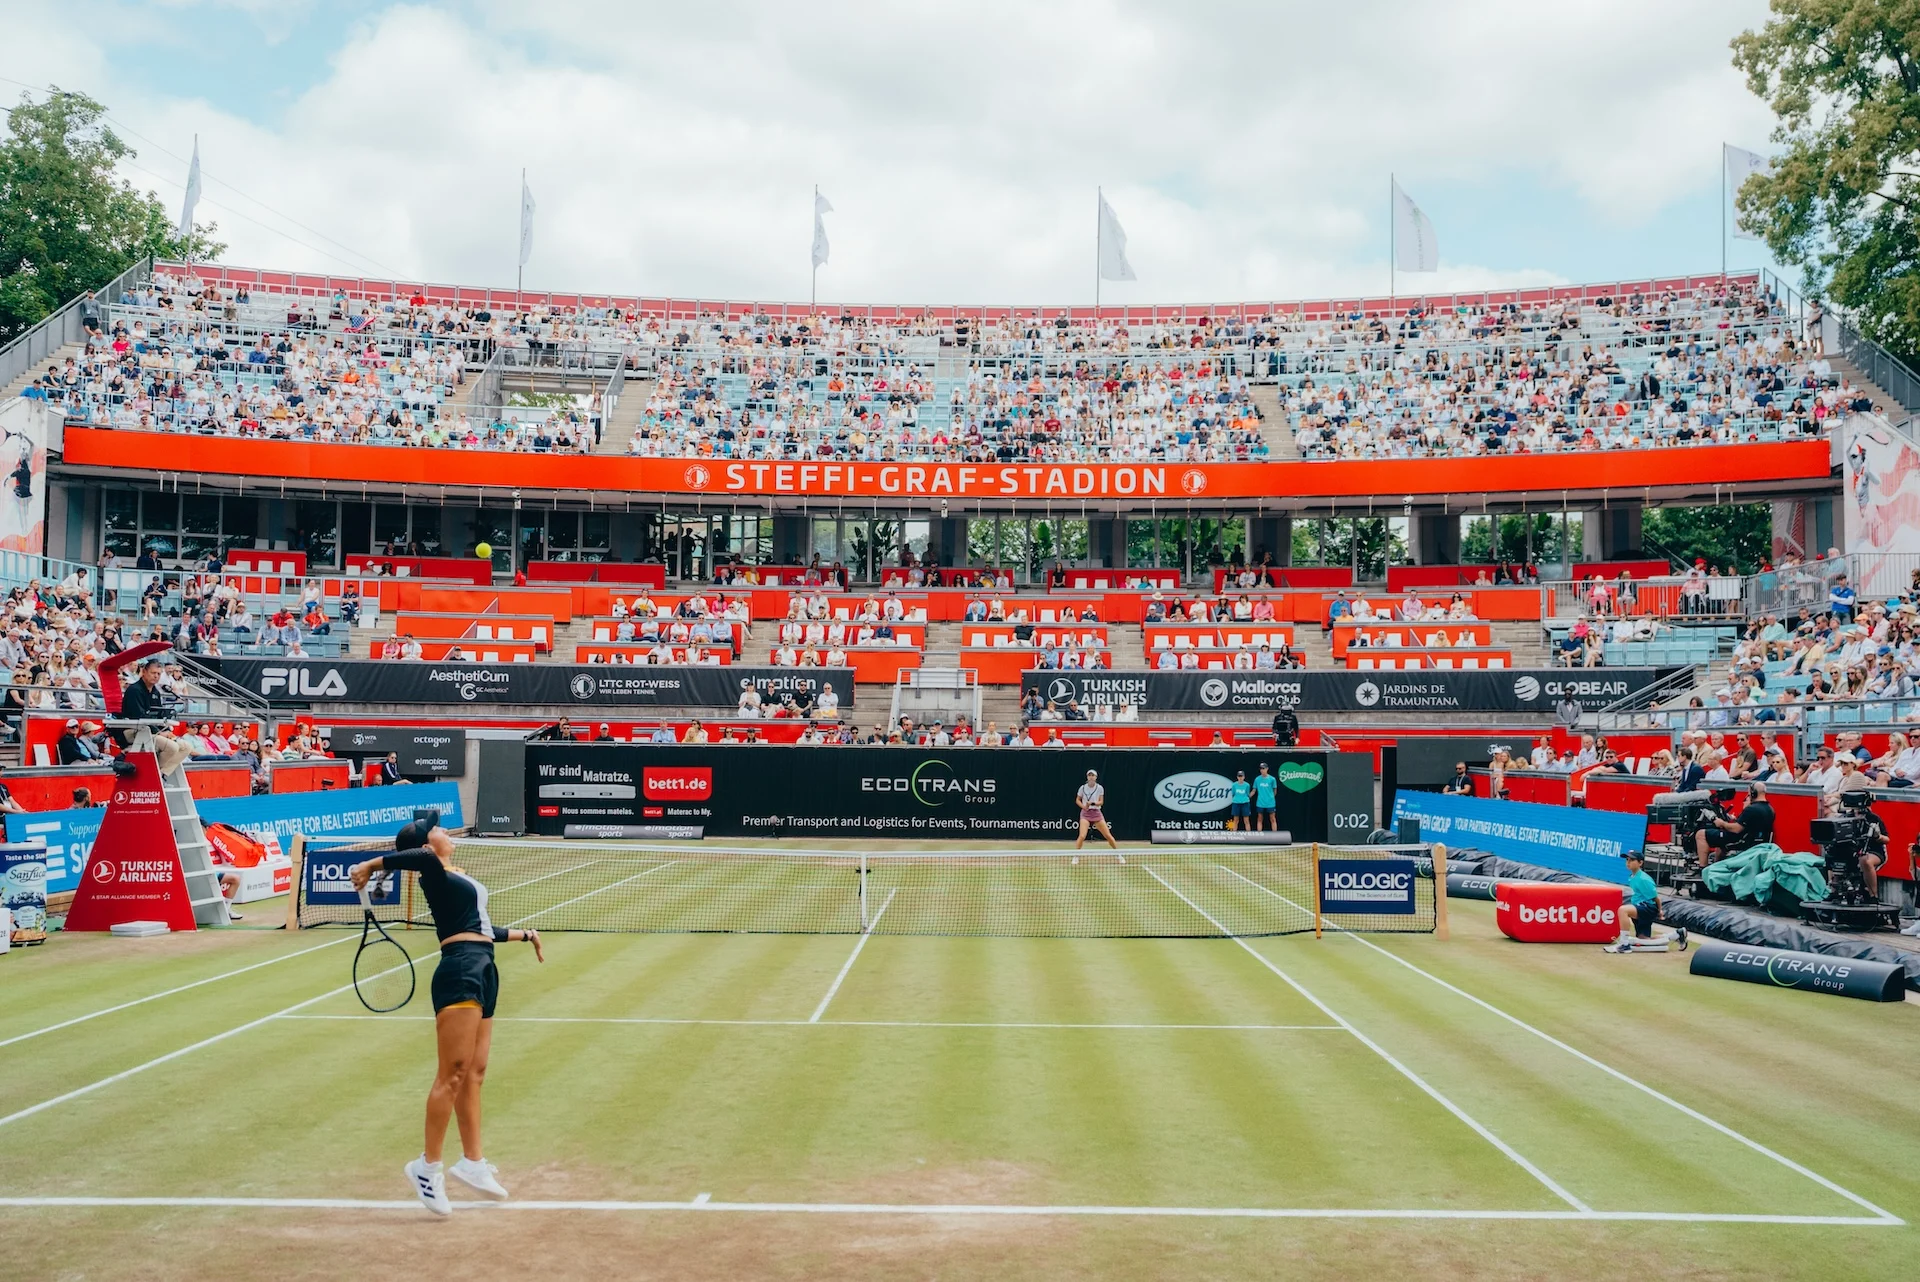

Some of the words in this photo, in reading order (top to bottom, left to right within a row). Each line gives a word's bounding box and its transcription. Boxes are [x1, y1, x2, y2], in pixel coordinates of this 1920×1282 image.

[726, 464, 1165, 494] STEFFI-GRAF-STADION
[261, 668, 347, 696] FILA
[429, 669, 509, 682] AesthetiCum
[599, 679, 623, 687] LTTC
[625, 680, 680, 688] ROT-WEISS
[1081, 679, 1146, 691] TURKISH
[1232, 680, 1300, 693] Mallorca
[1383, 684, 1427, 695] JARDINS
[1431, 685, 1445, 693] DE
[1545, 681, 1628, 695] GLOBEAIR
[1080, 692, 1147, 705] AIRLINES
[1232, 695, 1274, 706] Country
[1276, 695, 1301, 705] Club
[1383, 696, 1459, 706] TRAMUNTANA
[413, 736, 450, 747] octagon
[539, 765, 557, 776] Wir
[559, 765, 581, 776] sind
[583, 771, 633, 782] Matratze.
[648, 778, 707, 790] bett1.de
[1162, 780, 1232, 805] SanLucar
[965, 795, 996, 804] Group
[562, 807, 578, 815] Nous
[701, 808, 712, 817] My.
[263, 817, 303, 837] PARTNER
[304, 815, 321, 834] FOR
[322, 813, 343, 831] REAL
[343, 810, 369, 828] ESTATE
[491, 815, 510, 823] km/h
[742, 815, 785, 826] Premer
[787, 816, 839, 828] Transport
[840, 816, 861, 827] and
[864, 817, 909, 829] Logistics
[911, 817, 927, 827] for
[929, 818, 967, 830] Events,
[969, 818, 1040, 829] Tournaments
[1042, 819, 1062, 829] and
[1155, 820, 1181, 829] Taste
[1183, 820, 1200, 829] the
[1202, 820, 1223, 830] SUN
[1333, 813, 1369, 828] 0:02
[1431, 815, 1451, 833] GROUP
[1455, 817, 1469, 831] YOUR
[1468, 818, 1491, 835] PARTNER
[1492, 821, 1503, 837] FOR
[1503, 823, 1517, 839] REAL
[1518, 826, 1539, 843] ESTATE
[1539, 829, 1586, 852] INVESTMENTS
[1586, 837, 1595, 853] IN
[1595, 839, 1622, 858] BERLIN
[213, 836, 236, 861] Wilson
[120, 861, 173, 871] TURKISH
[119, 872, 173, 882] AIRLINES
[1325, 873, 1409, 889] HOLOGIC
[1461, 880, 1489, 889] ECO
[1520, 904, 1614, 924] bett1.de
[1814, 977, 1845, 991] Group
